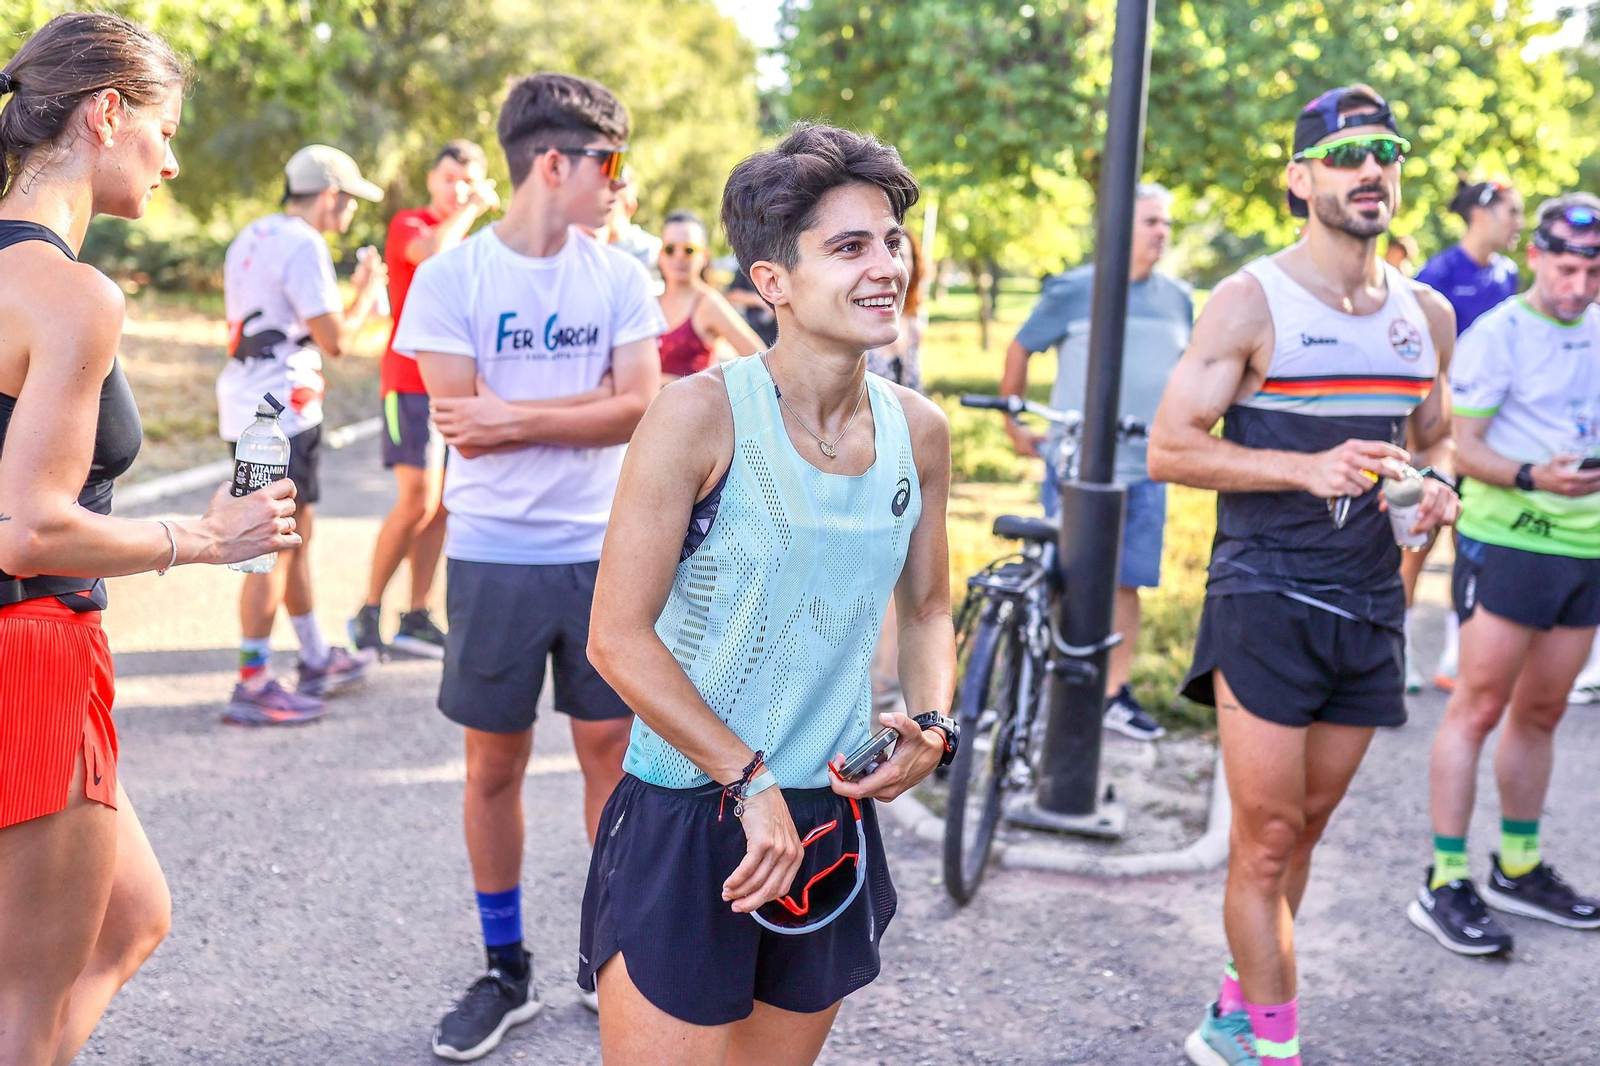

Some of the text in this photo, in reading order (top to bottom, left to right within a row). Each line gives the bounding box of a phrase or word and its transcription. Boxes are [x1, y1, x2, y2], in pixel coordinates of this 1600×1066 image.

[497, 312, 533, 353] FER
[250, 463, 285, 475] VITAMIN
[249, 471, 272, 482] WELL
